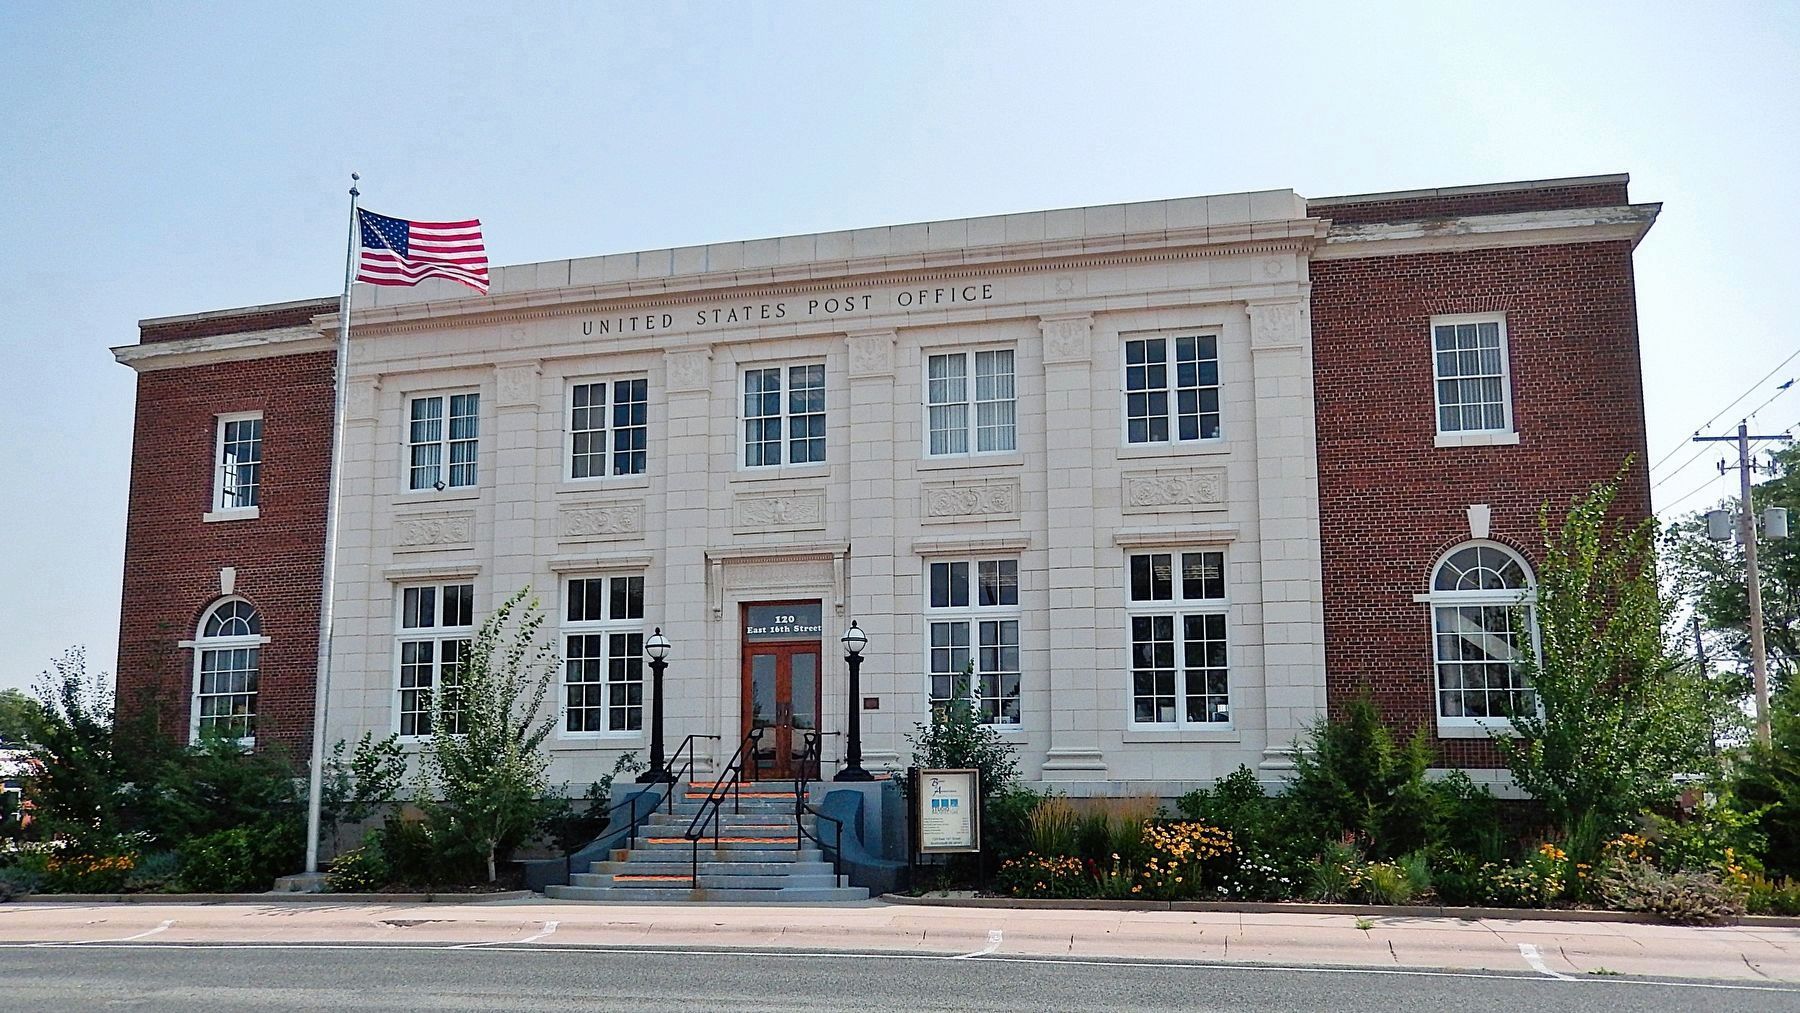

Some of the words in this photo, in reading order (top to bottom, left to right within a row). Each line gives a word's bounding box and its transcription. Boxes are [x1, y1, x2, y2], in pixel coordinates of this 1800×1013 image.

[583, 314, 673, 336] UNITED
[696, 303, 786, 325] STATES
[808, 295, 872, 315] POST
[897, 284, 993, 307] OFFICE
[774, 615, 795, 624] 120
[746, 626, 767, 634] East
[769, 625, 790, 633] 16th
